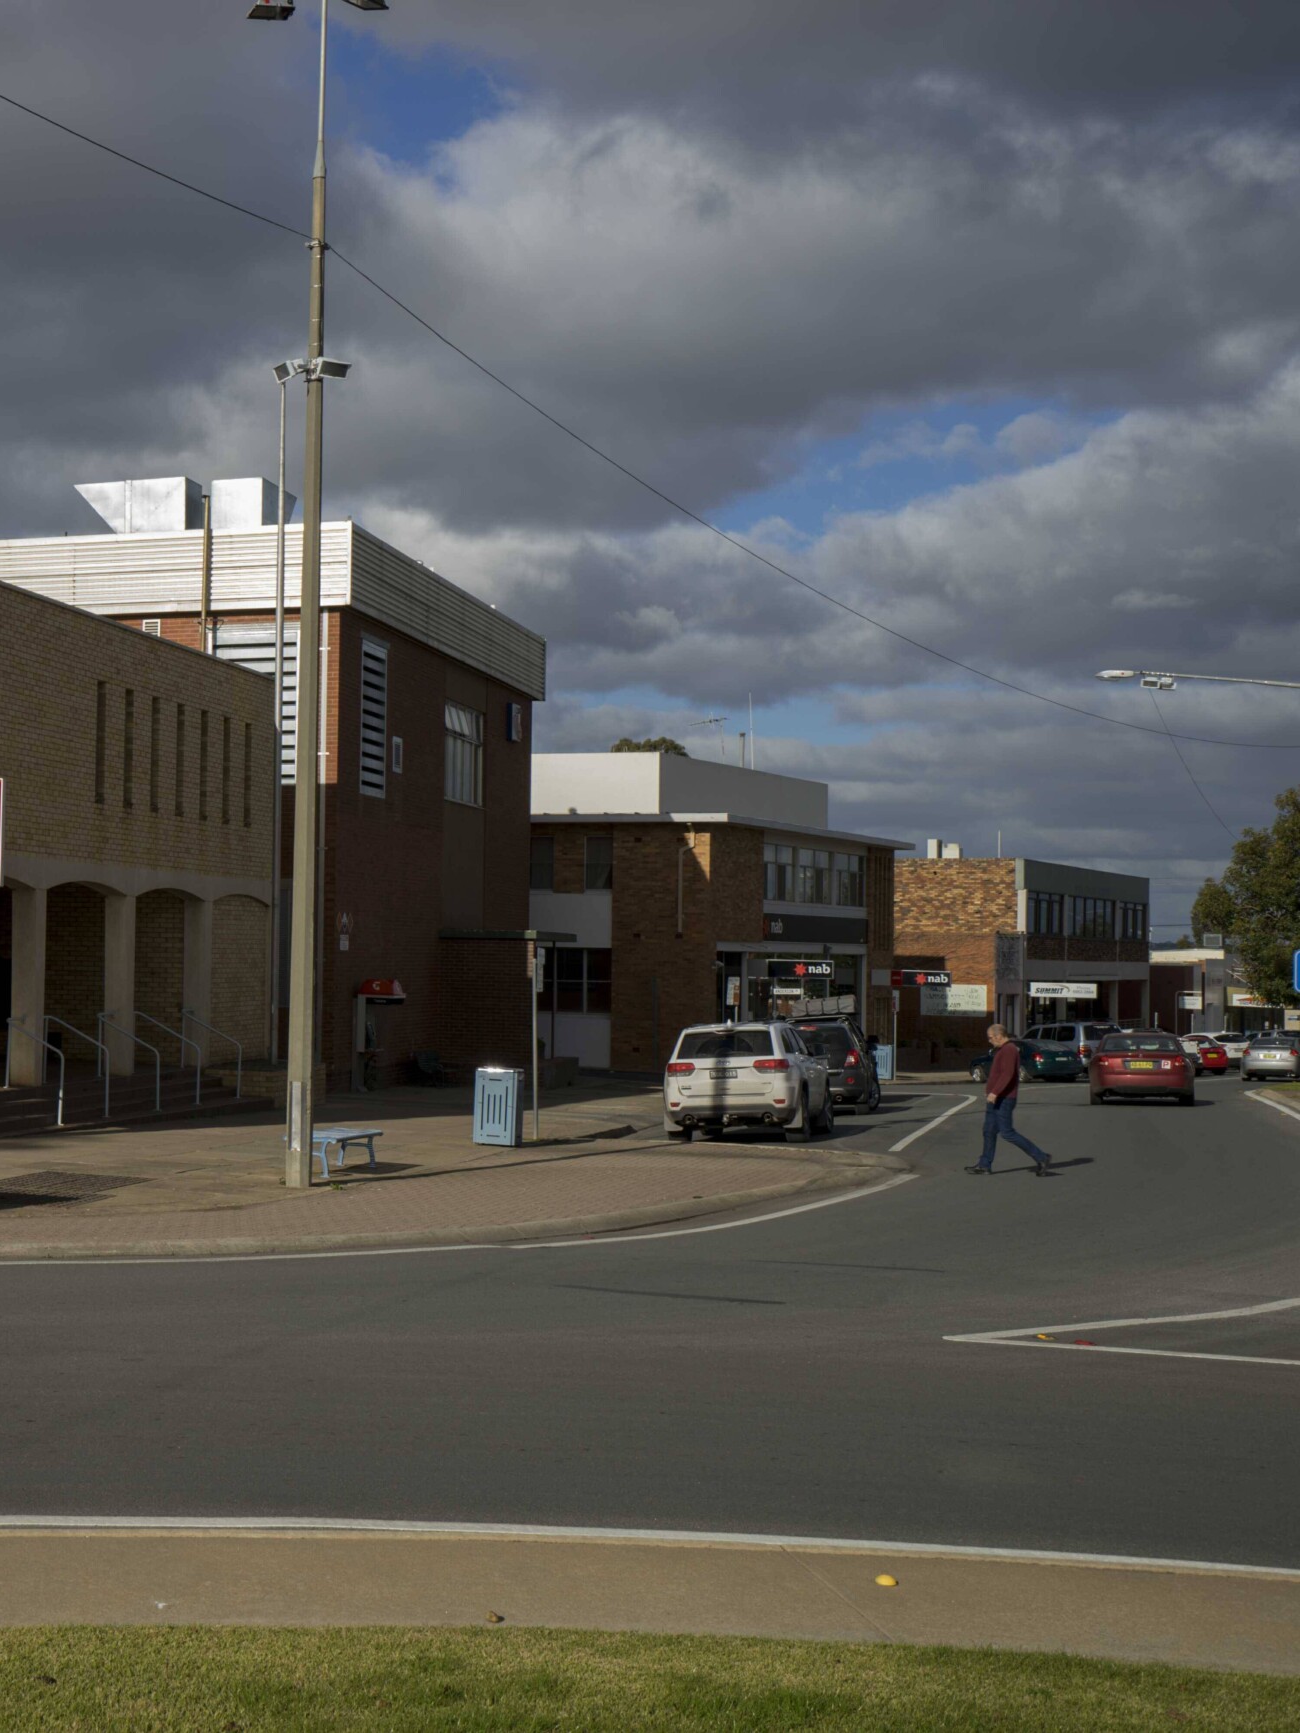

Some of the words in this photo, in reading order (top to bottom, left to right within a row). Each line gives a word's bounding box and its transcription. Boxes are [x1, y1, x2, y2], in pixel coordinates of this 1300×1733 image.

[770, 918, 784, 934] nab
[808, 963, 831, 974] nab
[927, 974, 949, 984] nab
[1034, 987, 1065, 995] SUMMIT
